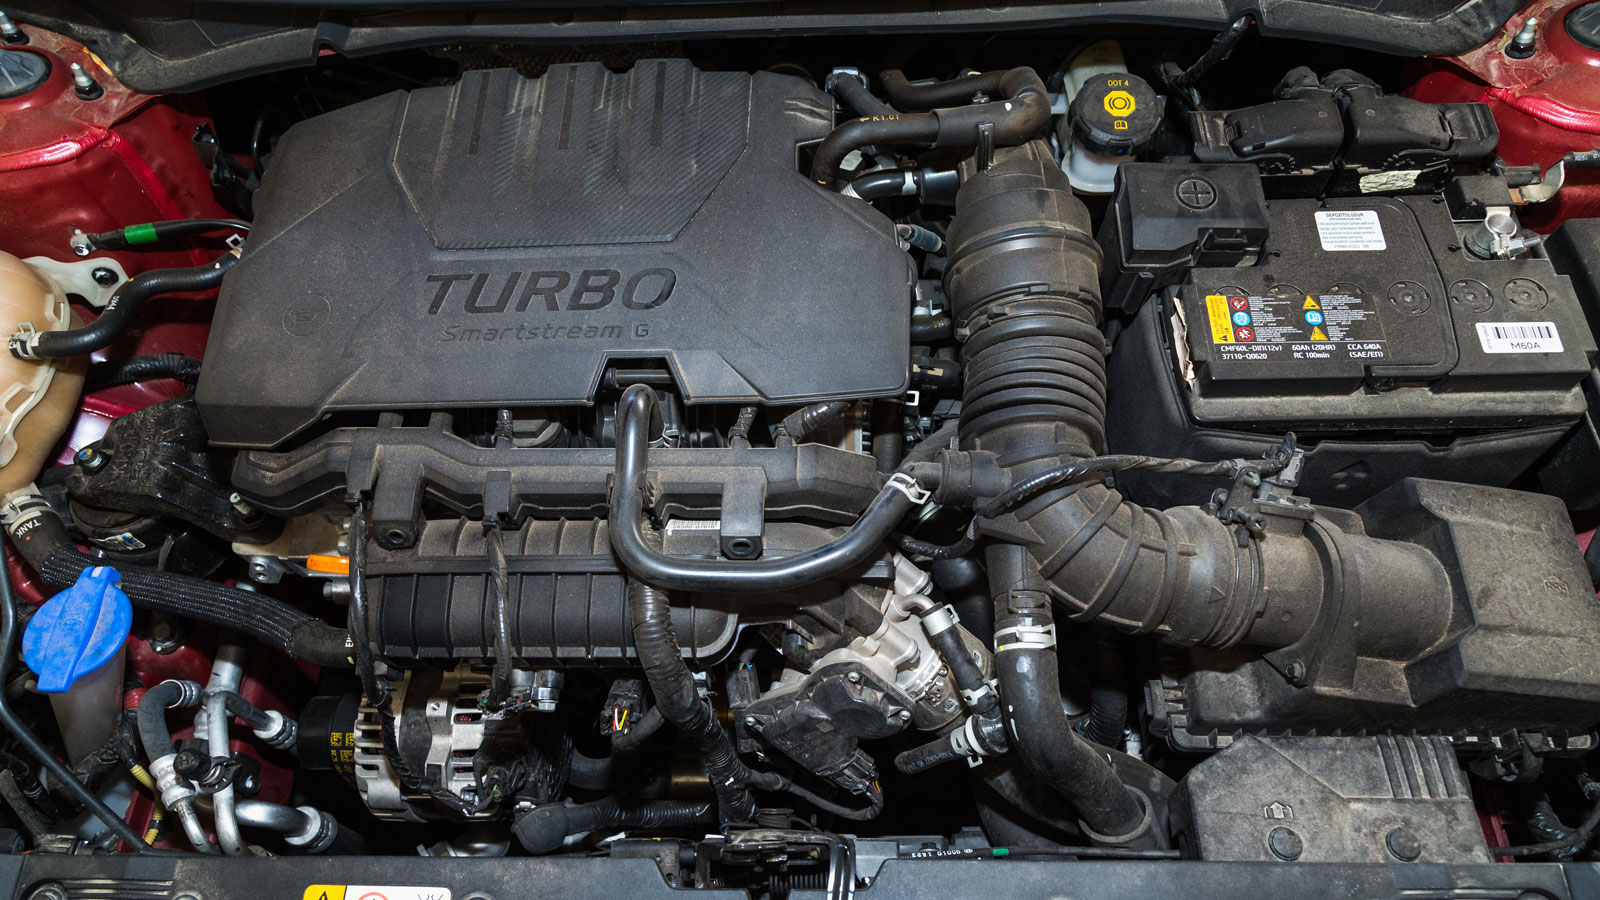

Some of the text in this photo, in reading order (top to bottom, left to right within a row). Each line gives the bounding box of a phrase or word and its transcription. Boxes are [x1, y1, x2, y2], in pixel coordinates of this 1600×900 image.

[1107, 79, 1129, 87] DOT 4
[426, 267, 677, 316] TURBO
[440, 322, 649, 343] Smartstream G
[1311, 343, 1336, 351] (20HR)
[1510, 341, 1542, 350] M60A
[1305, 351, 1330, 359] 100min
[15, 519, 42, 539] TANK
